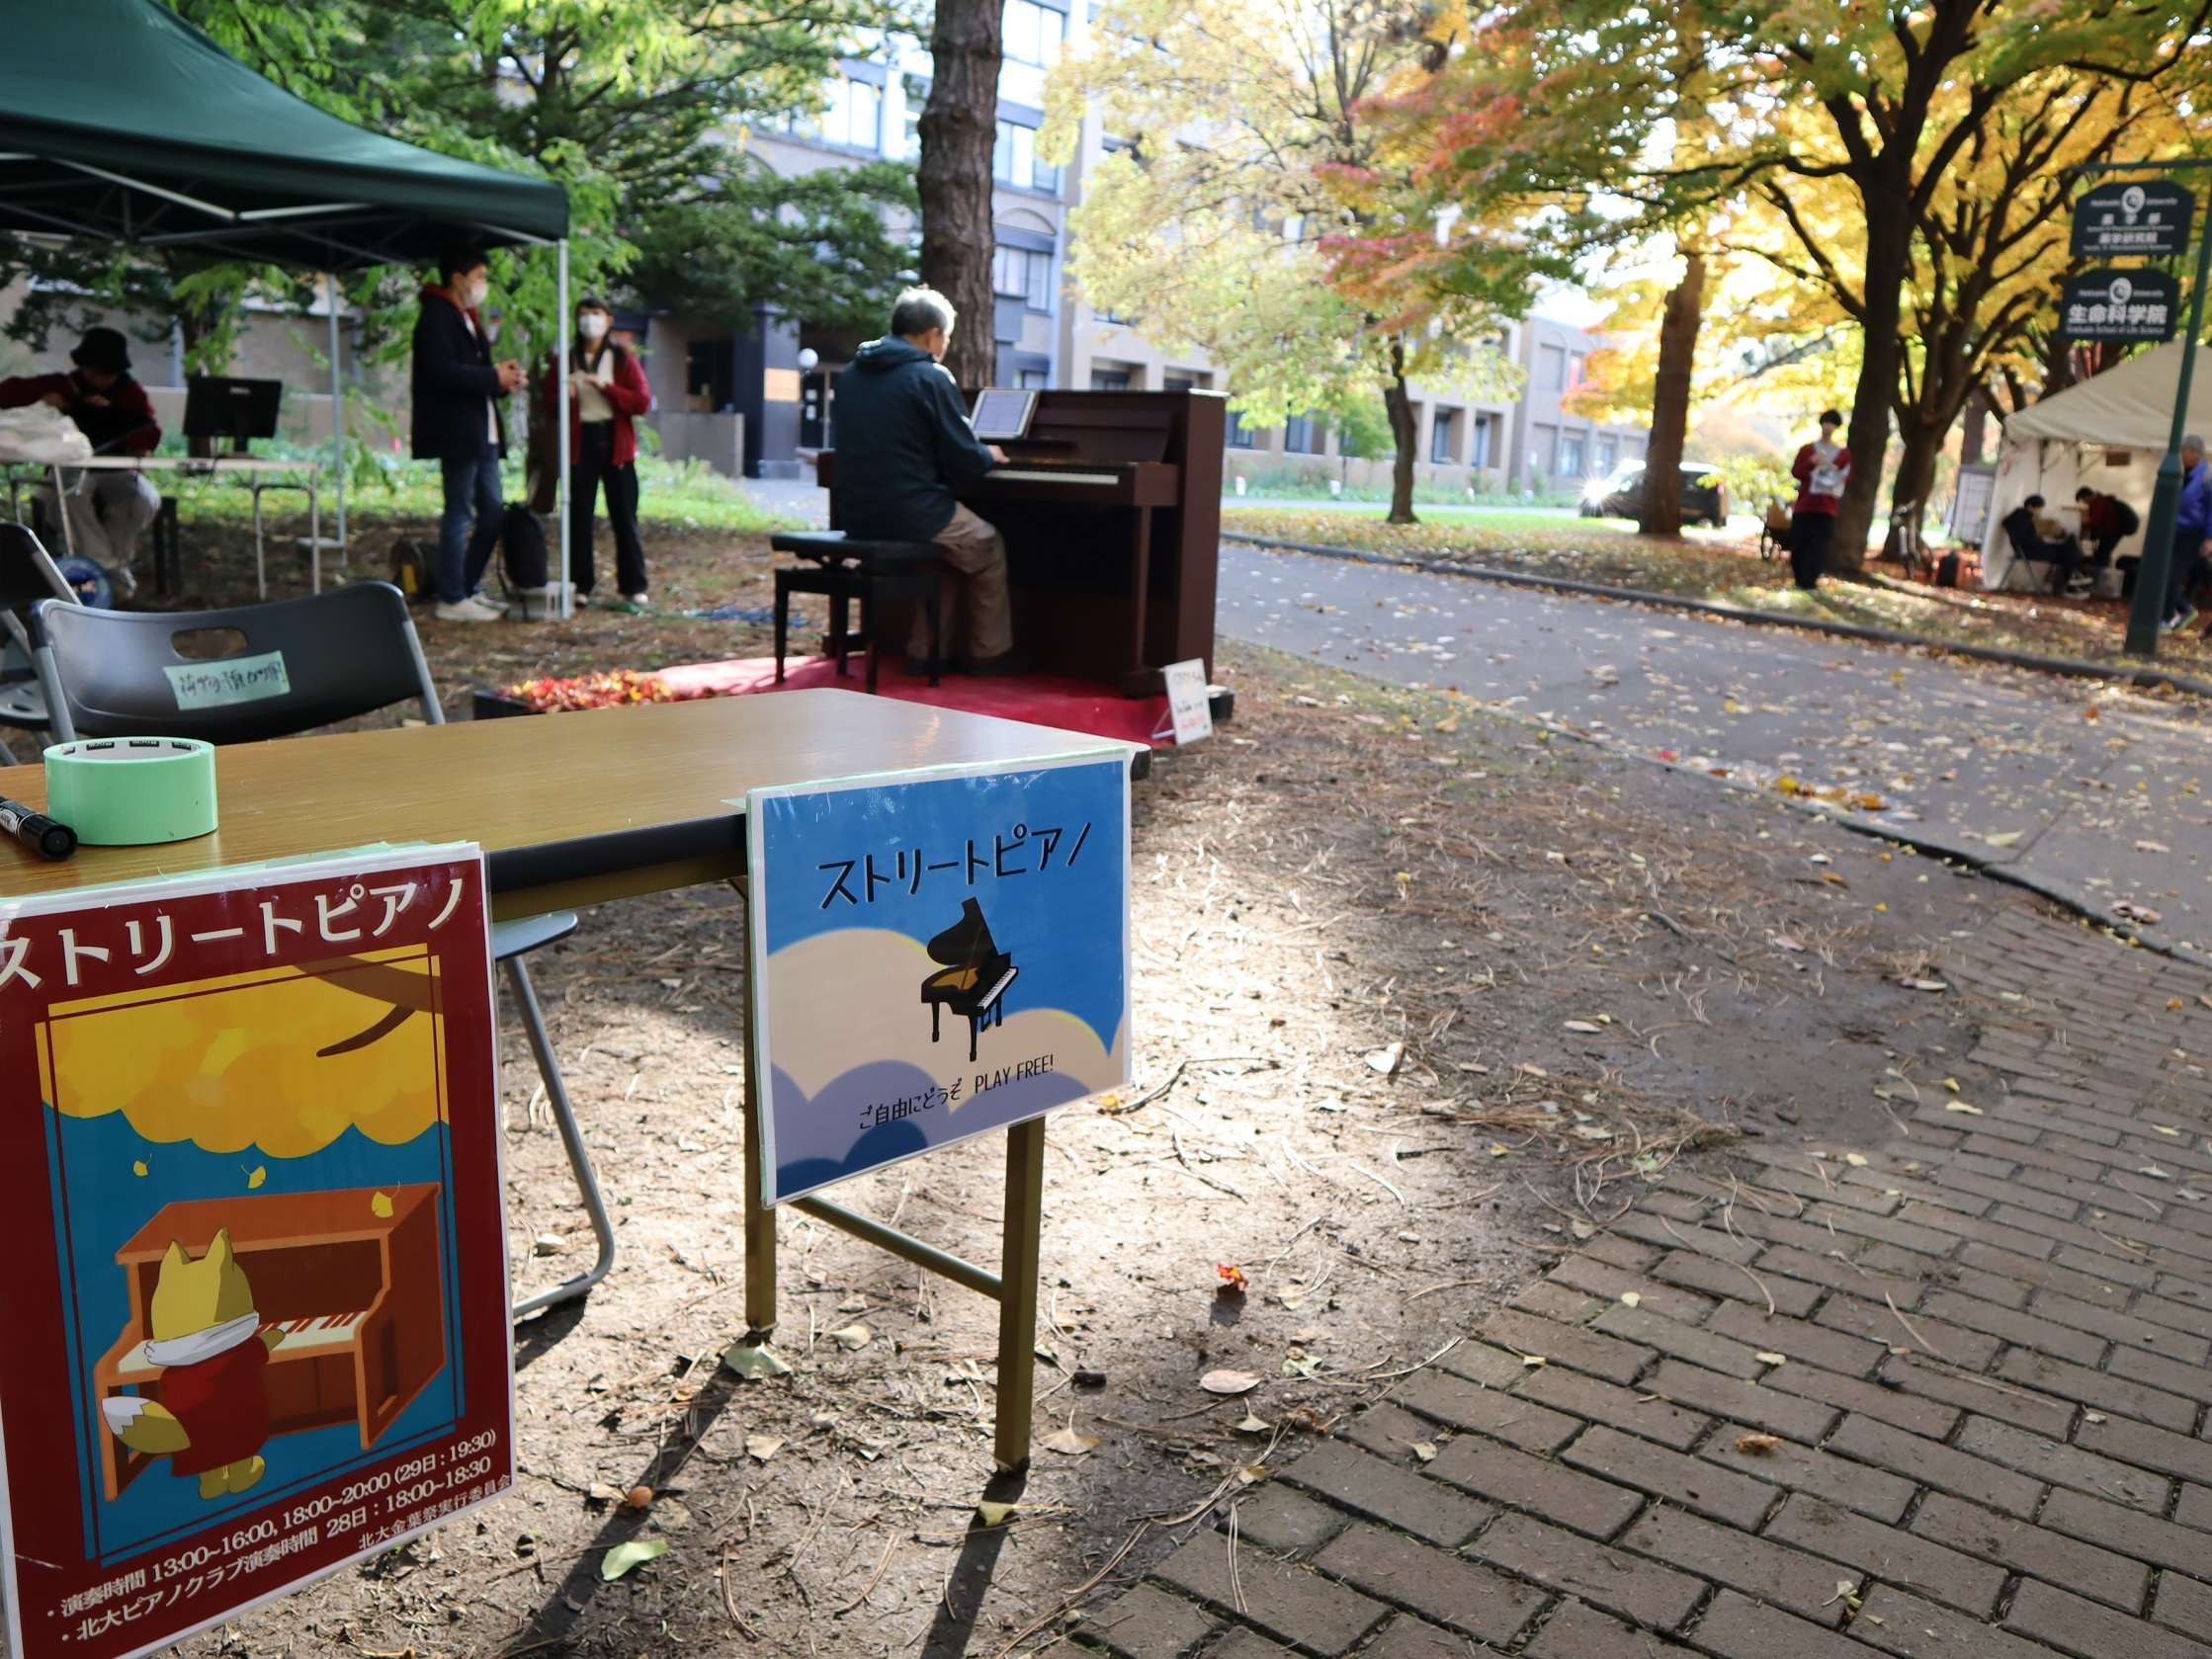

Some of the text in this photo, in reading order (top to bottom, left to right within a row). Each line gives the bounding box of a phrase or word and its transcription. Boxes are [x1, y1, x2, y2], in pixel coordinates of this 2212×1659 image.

[2068, 303, 2168, 325] 生命科学院
[818, 822, 1091, 909] ストリートピアノ
[0, 877, 464, 990] ストリートピアノ
[860, 1054, 1054, 1129] ご自由にどうぞ PLAY FREE!
[359, 1473, 512, 1550] 北大金葉祭実行委員会
